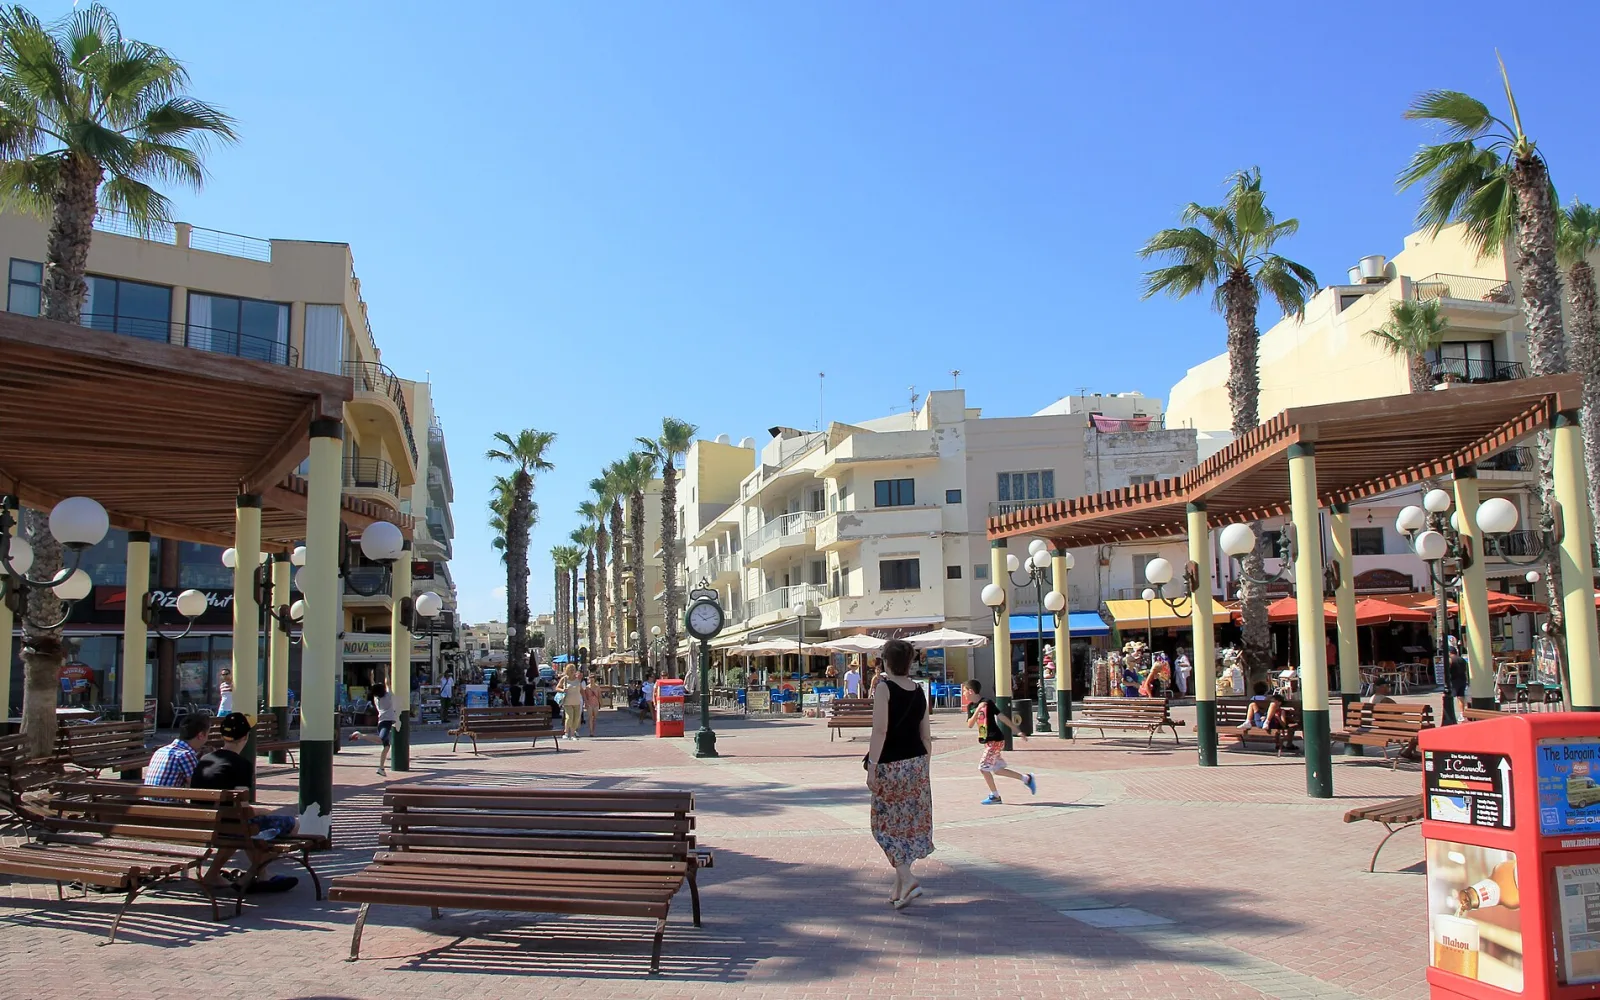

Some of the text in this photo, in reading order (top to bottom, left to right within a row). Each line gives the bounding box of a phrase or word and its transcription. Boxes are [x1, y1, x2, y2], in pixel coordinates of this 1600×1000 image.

[151, 590, 235, 607] Piz Hut
[871, 629, 888, 640] the
[344, 642, 369, 654] NOVA
[1543, 747, 1561, 761] The
[1563, 746, 1595, 763] Bargain
[1442, 935, 1469, 950] Mahou
